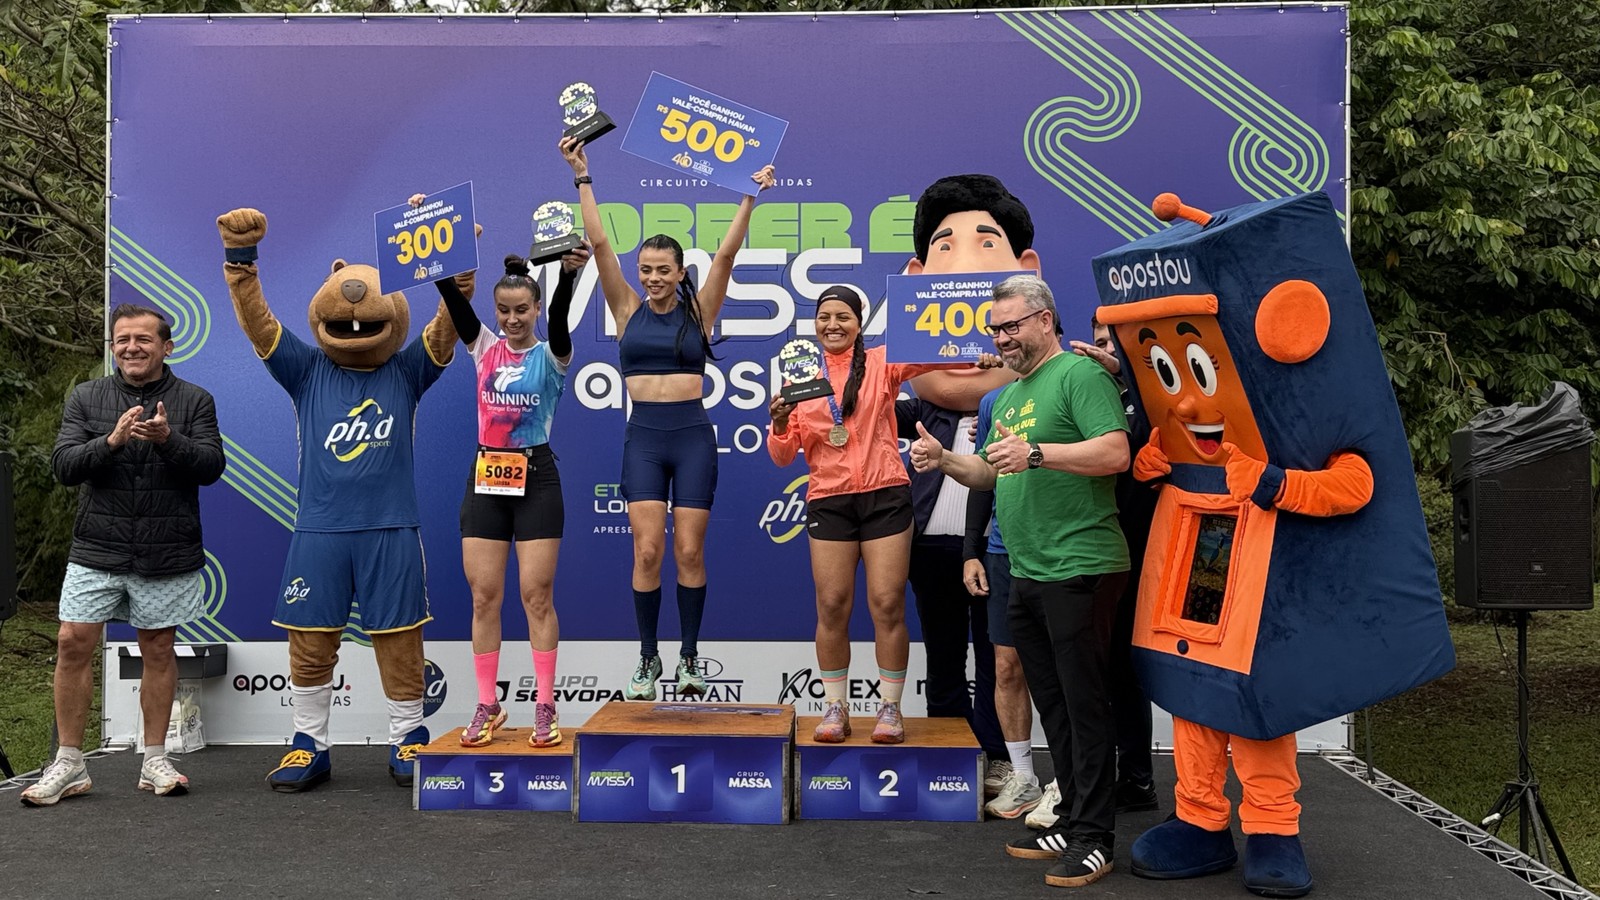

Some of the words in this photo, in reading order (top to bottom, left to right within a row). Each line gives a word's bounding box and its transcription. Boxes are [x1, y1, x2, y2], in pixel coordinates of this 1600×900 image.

[656, 103, 669, 114] R$
[672, 96, 728, 124] VALE-COMPRA
[728, 119, 756, 133] HAVAN
[689, 95, 711, 109] VOCÊ
[711, 104, 745, 121] GANHOU
[640, 179, 708, 187] CIRCUITO
[419, 200, 444, 212] GANHOU
[393, 210, 434, 229] VALE-COMPRA
[434, 205, 454, 217] HAVAN
[567, 202, 852, 254] ORRER
[1108, 252, 1191, 297] apostou
[931, 281, 955, 290] VOCÊ
[955, 281, 993, 290] GANHOU
[916, 289, 978, 299] VALE-COMPRA
[904, 304, 917, 312] R$
[481, 391, 541, 406] RUNNING
[506, 405, 521, 413] Every
[324, 413, 394, 450] ph.d
[486, 464, 523, 480] 5082
[757, 492, 807, 529] ph.
[284, 584, 311, 598] ph.d
[518, 675, 599, 688] GUPO
[781, 670, 882, 700] KOEX
[422, 780, 465, 790] MASSA
[488, 772, 505, 793] 3
[527, 780, 568, 791] MASSA
[586, 776, 634, 787] MASSA
[670, 764, 685, 794] 1
[728, 777, 773, 789] MASSA
[808, 780, 852, 790] MASSA
[878, 769, 899, 797] 2
[929, 781, 970, 792] MASSA
